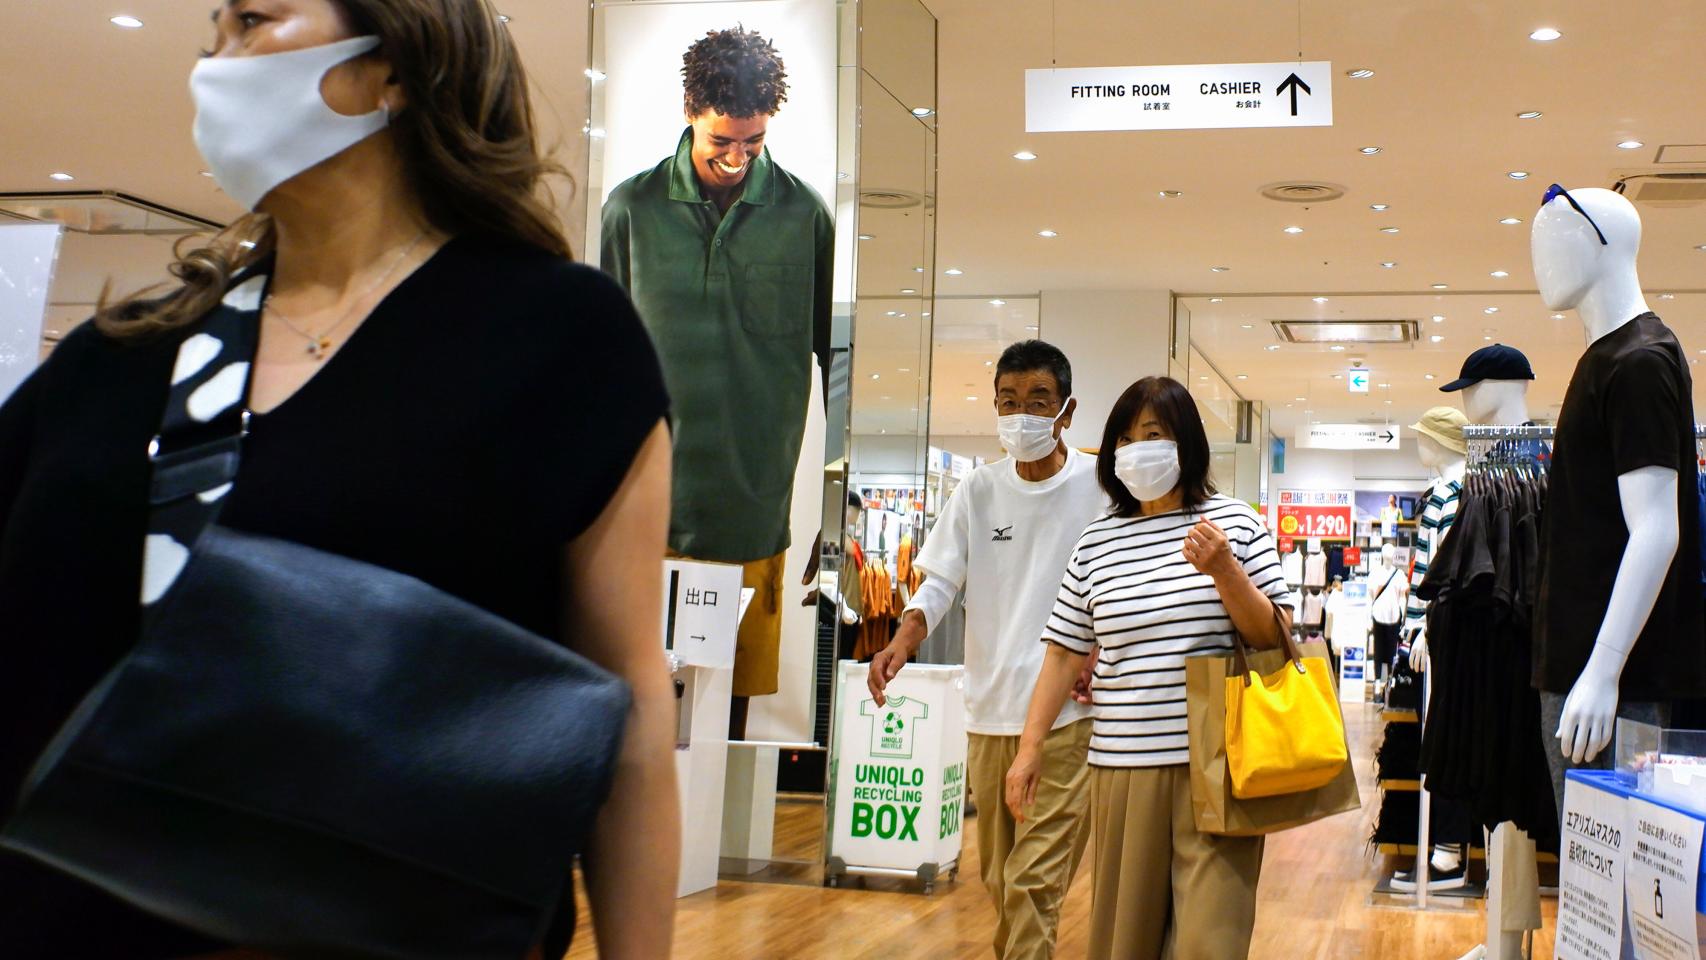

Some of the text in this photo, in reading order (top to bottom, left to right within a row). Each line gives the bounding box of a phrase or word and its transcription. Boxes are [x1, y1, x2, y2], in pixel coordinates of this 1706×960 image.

[1071, 83, 1171, 98] FITTING ROOM
[1200, 81, 1261, 95] CASHIER
[1143, 102, 1171, 111] 試着室
[1236, 100, 1261, 109] お会計
[685, 587, 718, 606] 出口
[855, 764, 924, 789] UNIQLO
[854, 787, 922, 803] RECYCLING
[851, 802, 921, 842] BOX
[939, 799, 961, 840] BOX
[1566, 811, 1621, 848] エアリズムマスクの
[1569, 840, 1613, 878] 品切れについて
